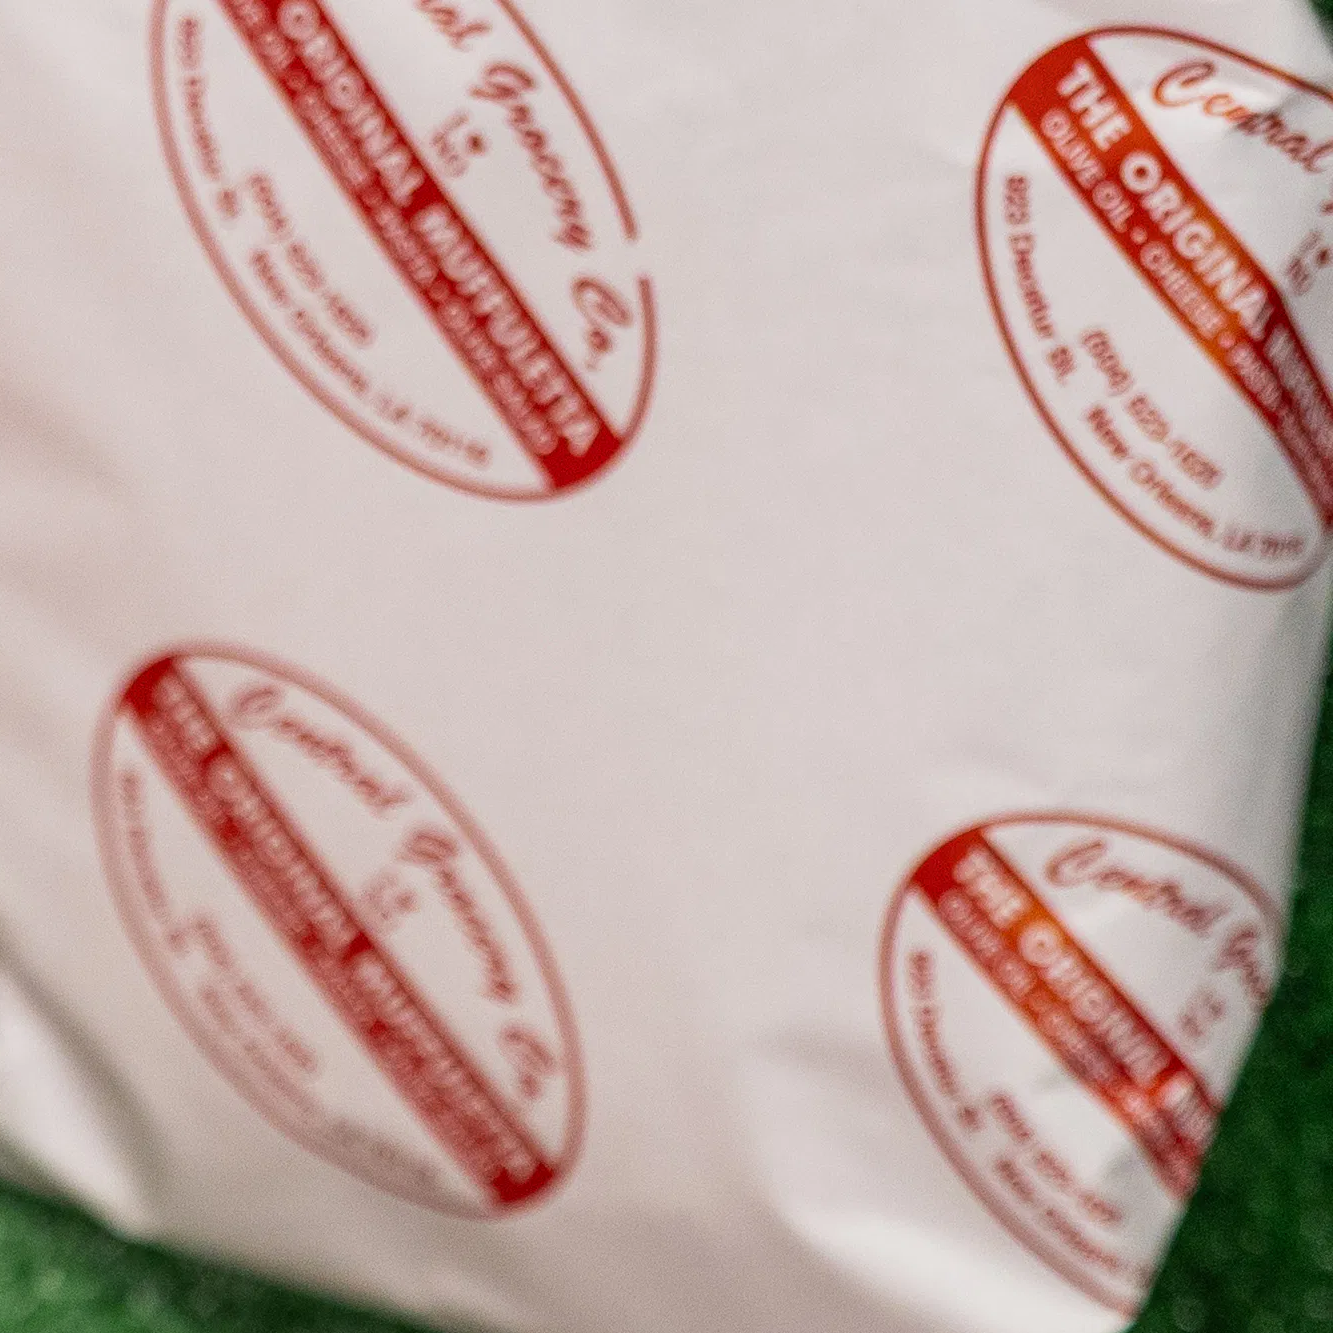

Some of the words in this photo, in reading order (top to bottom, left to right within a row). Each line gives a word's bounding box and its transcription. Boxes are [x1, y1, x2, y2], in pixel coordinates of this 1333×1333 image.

[276, 0, 426, 205] ORIGINAL
[1039, 106, 1106, 191] OLIVE
[1091, 179, 1135, 234] OIL
[1055, 58, 1132, 152] THE
[1119, 150, 1286, 342] ORIGINAL
[952, 842, 1029, 929] THE
